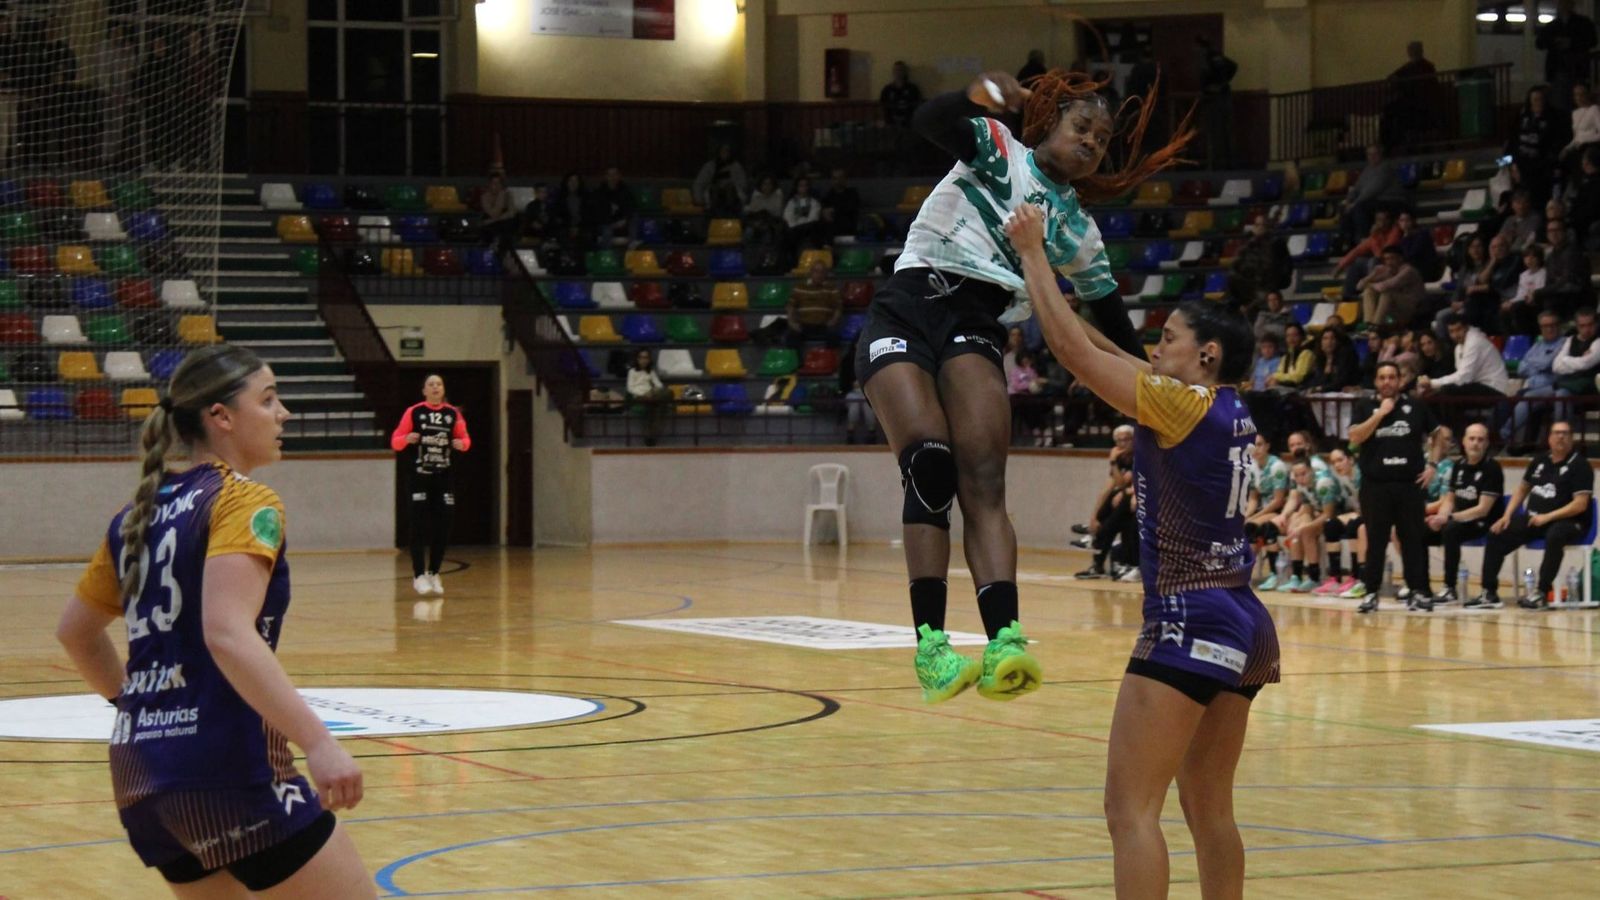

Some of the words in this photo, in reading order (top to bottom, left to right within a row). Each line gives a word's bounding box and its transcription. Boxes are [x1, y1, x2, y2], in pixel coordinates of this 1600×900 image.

[870, 344, 895, 360] suma
[428, 412, 442, 424] 12
[119, 526, 182, 642] 23
[137, 705, 199, 728] Asturias
[164, 724, 198, 737] natural
